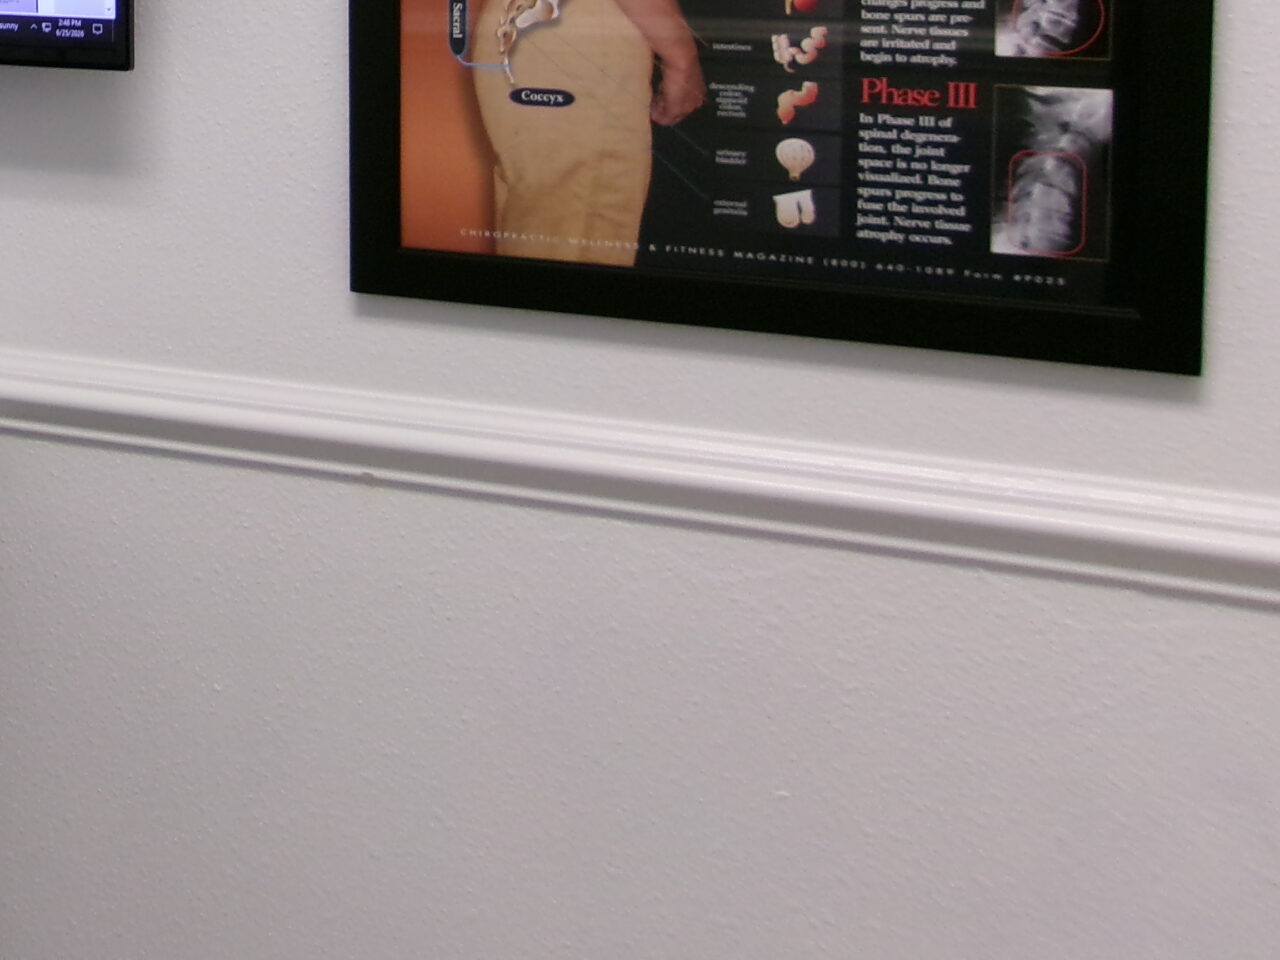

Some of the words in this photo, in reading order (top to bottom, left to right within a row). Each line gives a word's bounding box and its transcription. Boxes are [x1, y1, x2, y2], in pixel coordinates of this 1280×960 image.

[911, 0, 959, 10] progress
[961, 0, 985, 9] and
[453, 2, 463, 38] Sacral
[861, 10, 890, 20] bone
[894, 13, 925, 22] spurs
[928, 13, 947, 21] are
[0, 22, 19, 32] sunny
[892, 25, 927, 35] Nerve
[929, 26, 968, 37] tissues
[521, 90, 564, 103] Coccyx
[860, 76, 941, 107] Phase
[947, 81, 978, 108] III
[666, 245, 724, 258] FITNESS
[734, 251, 815, 265] MAGAZINE
